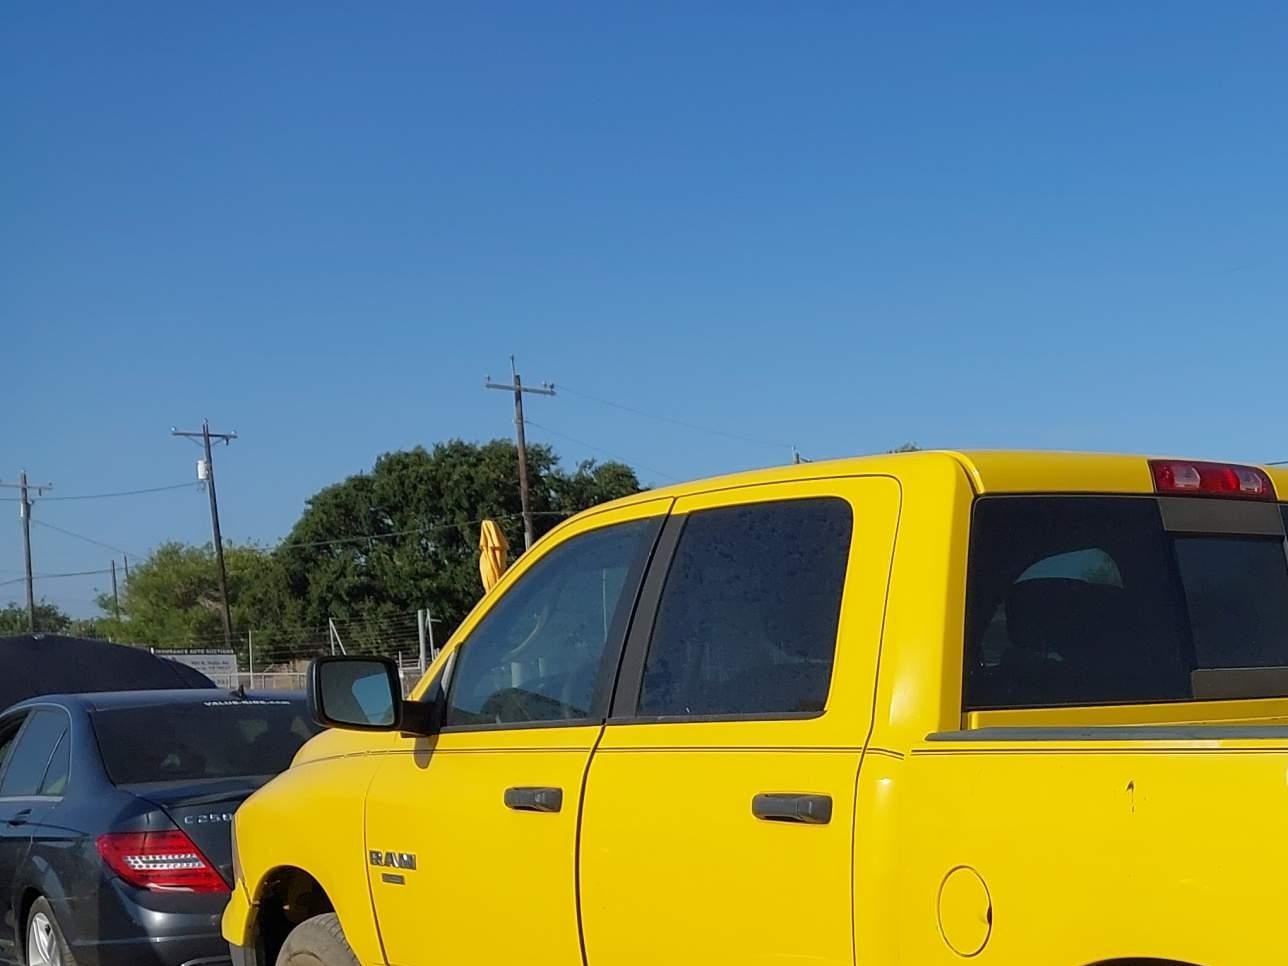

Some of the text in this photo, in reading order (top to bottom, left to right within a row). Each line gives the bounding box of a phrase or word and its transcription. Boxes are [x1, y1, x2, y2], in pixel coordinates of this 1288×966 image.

[184, 813, 232, 824] C 250
[369, 850, 417, 871] RAM
